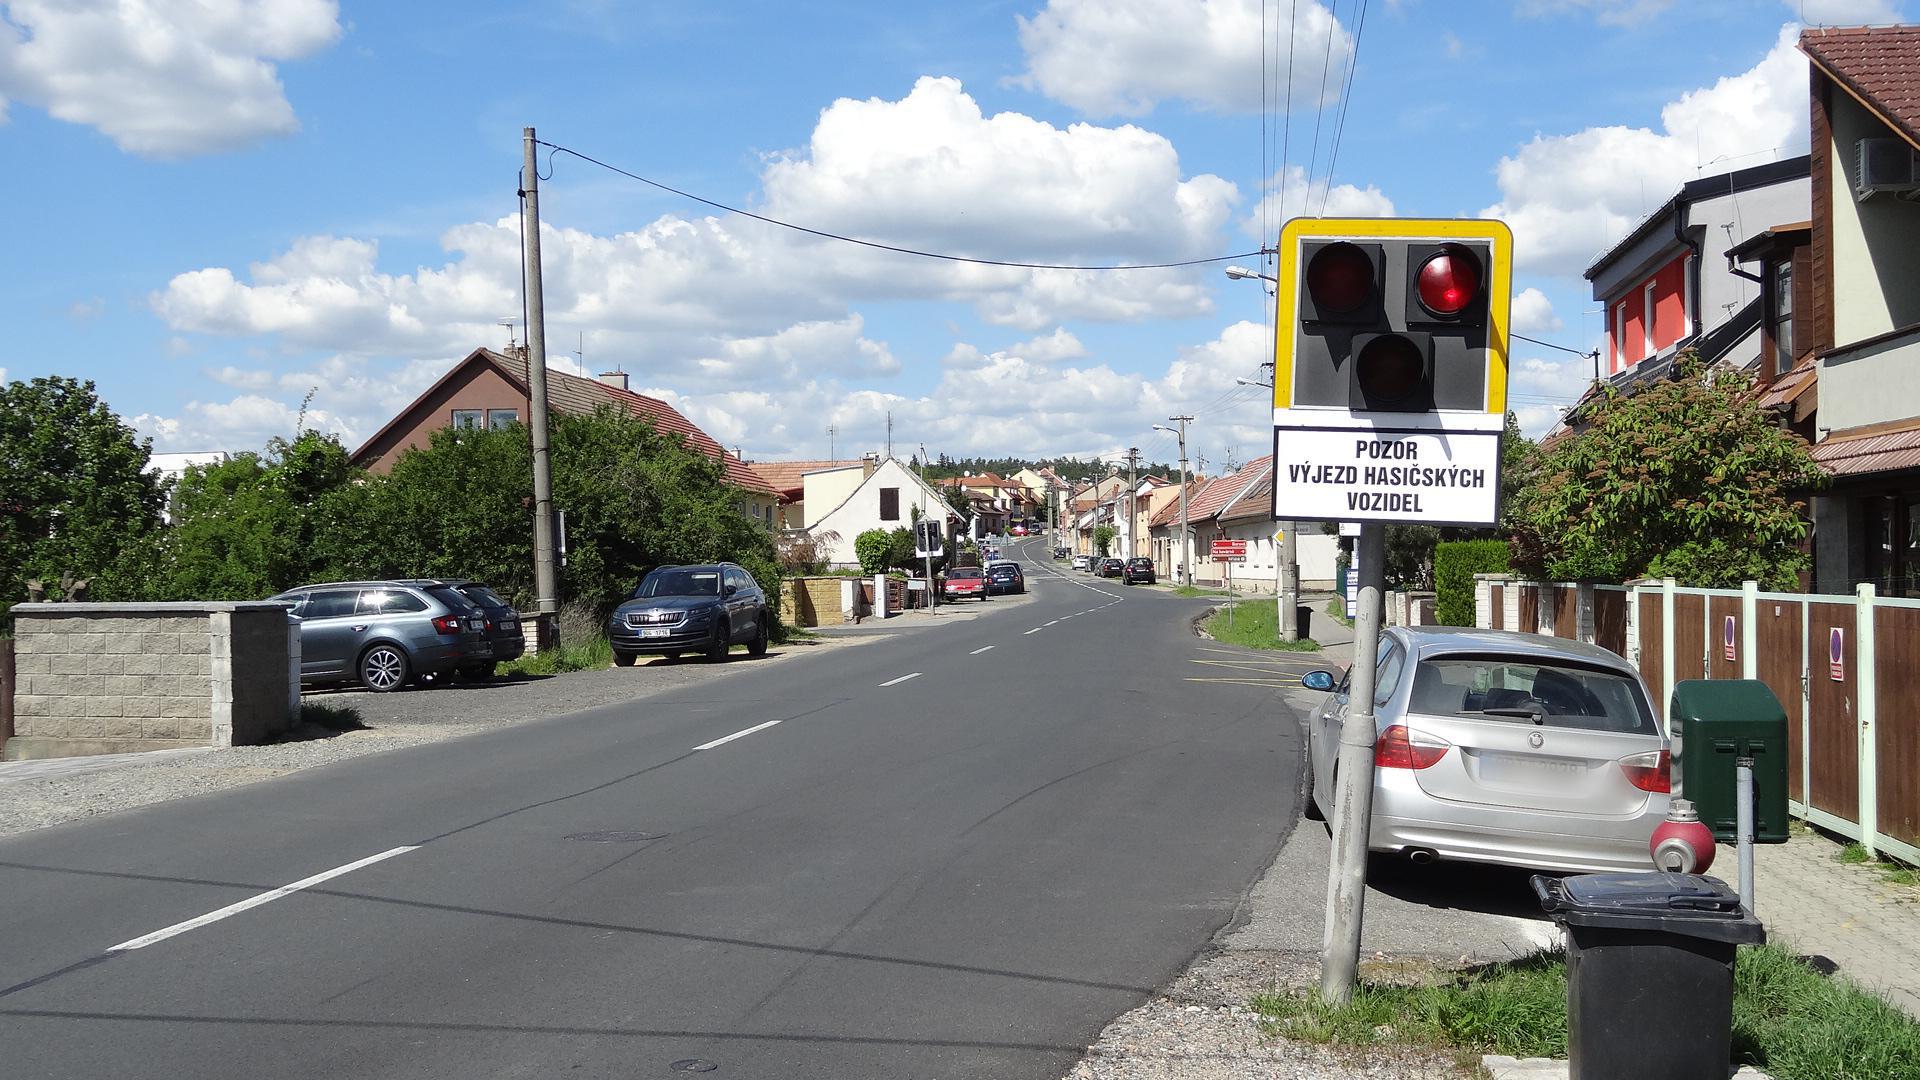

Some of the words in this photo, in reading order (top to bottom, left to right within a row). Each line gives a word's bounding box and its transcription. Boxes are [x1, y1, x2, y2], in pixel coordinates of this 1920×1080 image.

[1356, 440, 1418, 460] POZOR
[1289, 461, 1358, 485] VÝJEZD
[1364, 464, 1485, 488] HASIČSKÝCH
[1347, 492, 1423, 513] VOZIDEL
